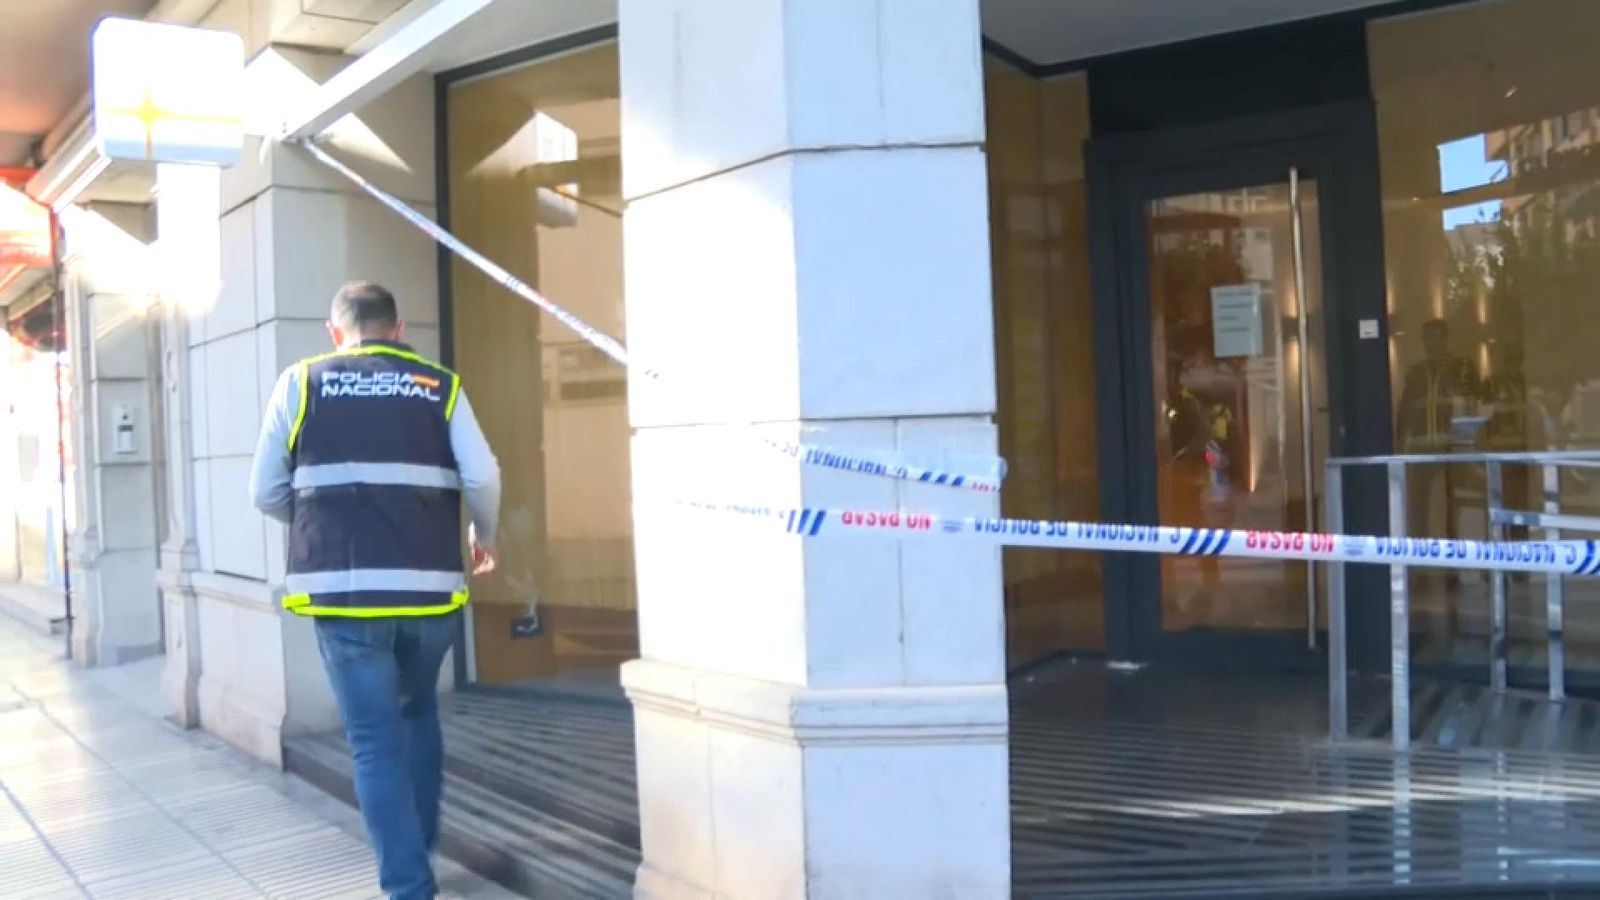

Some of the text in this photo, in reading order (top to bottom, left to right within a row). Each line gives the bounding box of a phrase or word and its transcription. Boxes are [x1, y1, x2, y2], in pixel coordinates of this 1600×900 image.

[321, 371, 414, 386] POLICIA
[321, 383, 441, 402] NACIONAL
[1076, 522, 1159, 542] NACIONAL
[1245, 530, 1304, 551] PASAR
[1309, 533, 1335, 553] NO
[1375, 536, 1443, 558] POLICIA
[1476, 540, 1556, 564] NACIONAL
